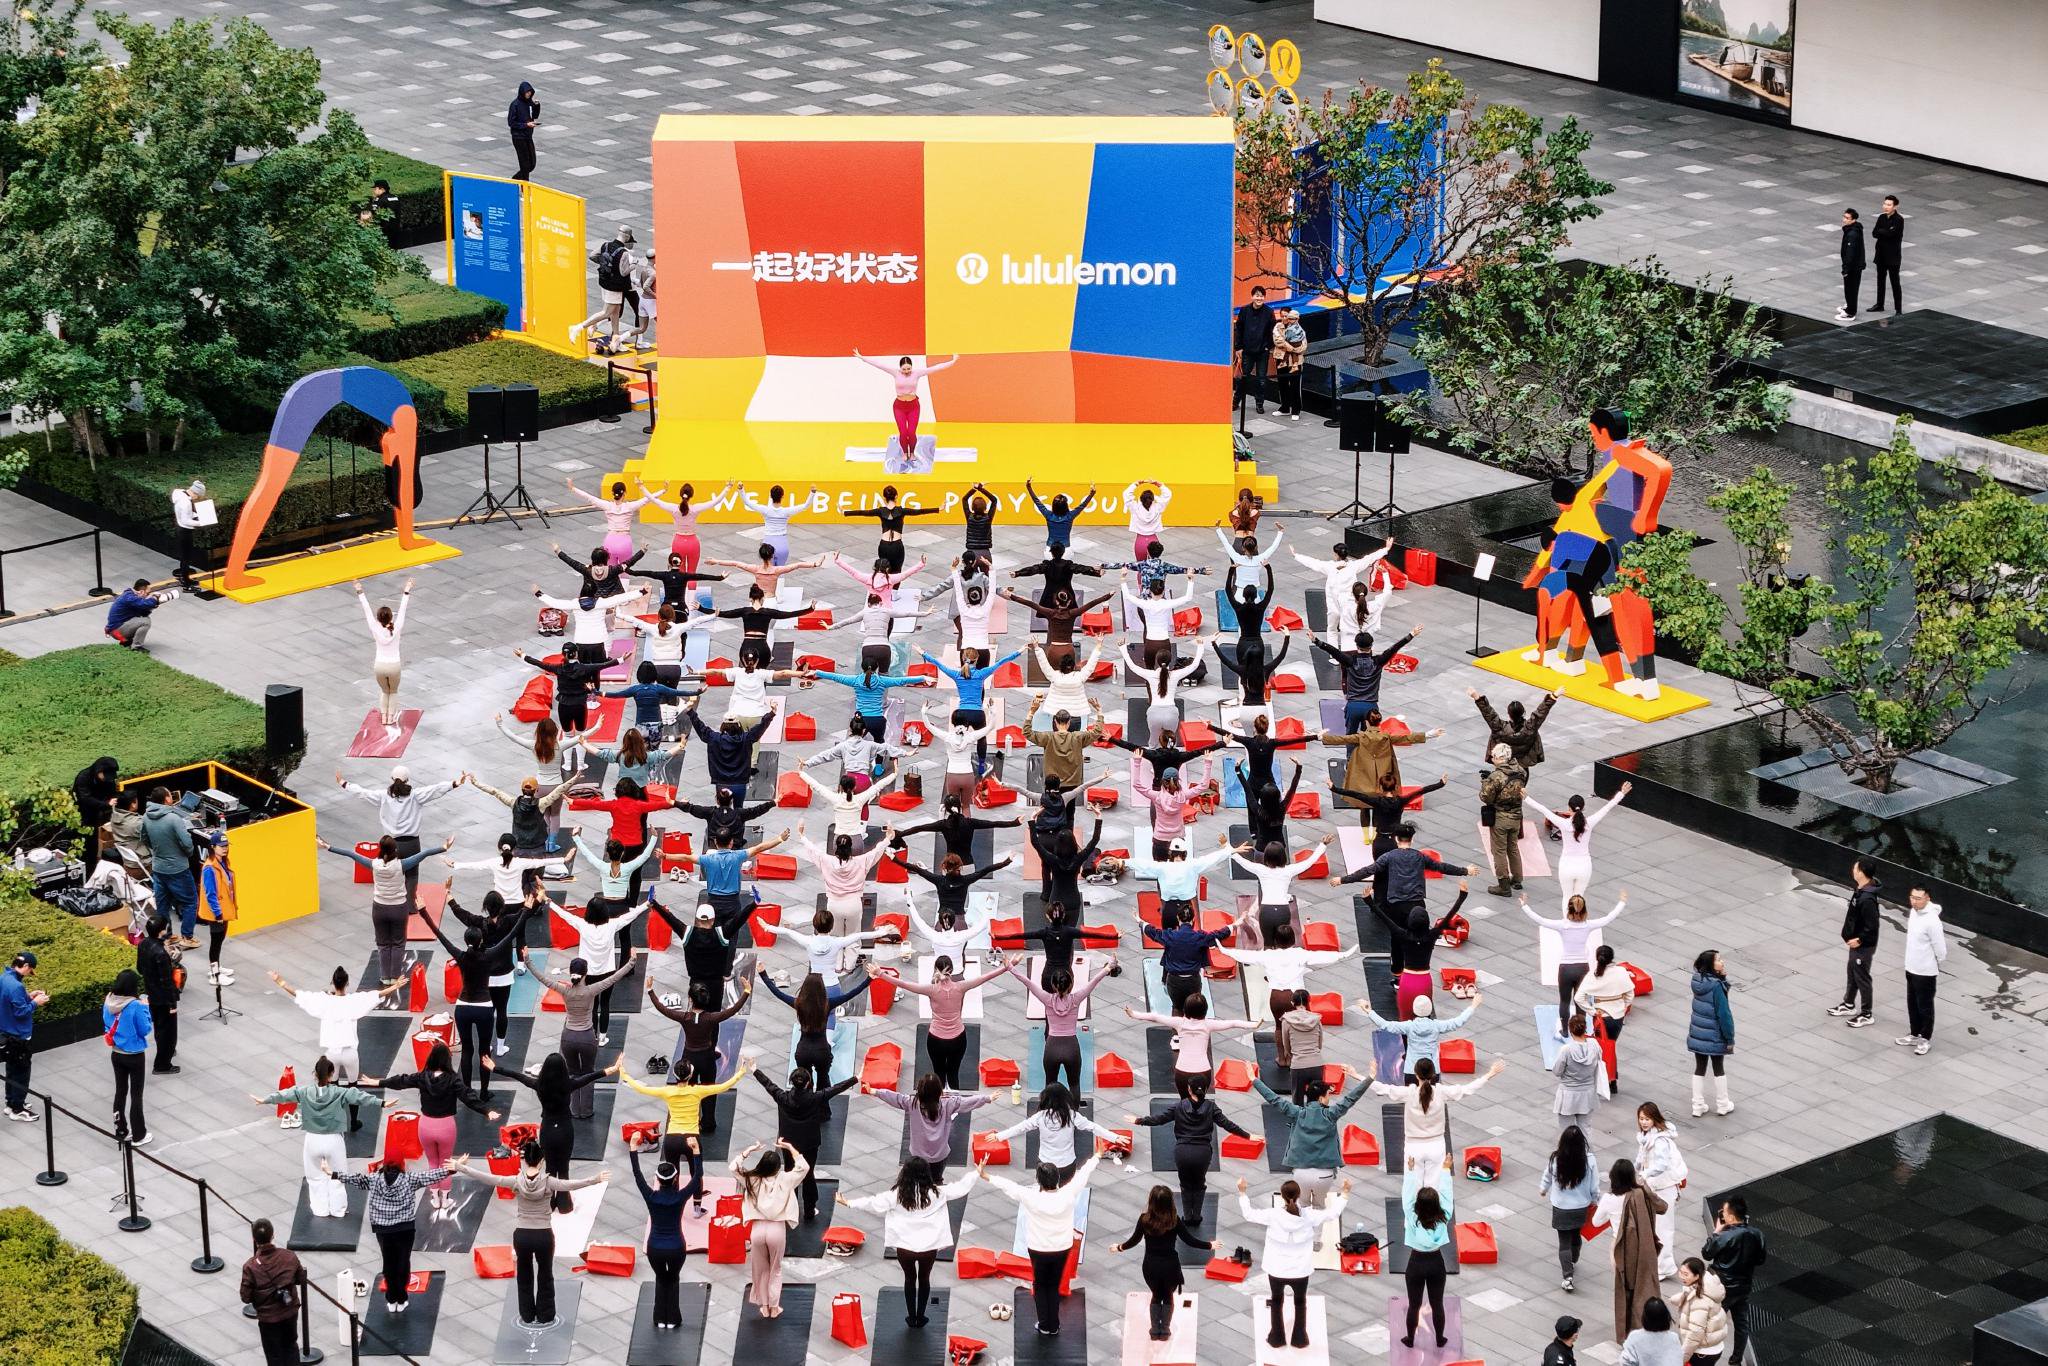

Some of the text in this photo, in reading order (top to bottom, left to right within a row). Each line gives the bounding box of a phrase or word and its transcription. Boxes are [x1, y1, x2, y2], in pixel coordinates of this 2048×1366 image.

[712, 251, 918, 284] 一起好状态
[1002, 254, 1176, 285] lululemon
